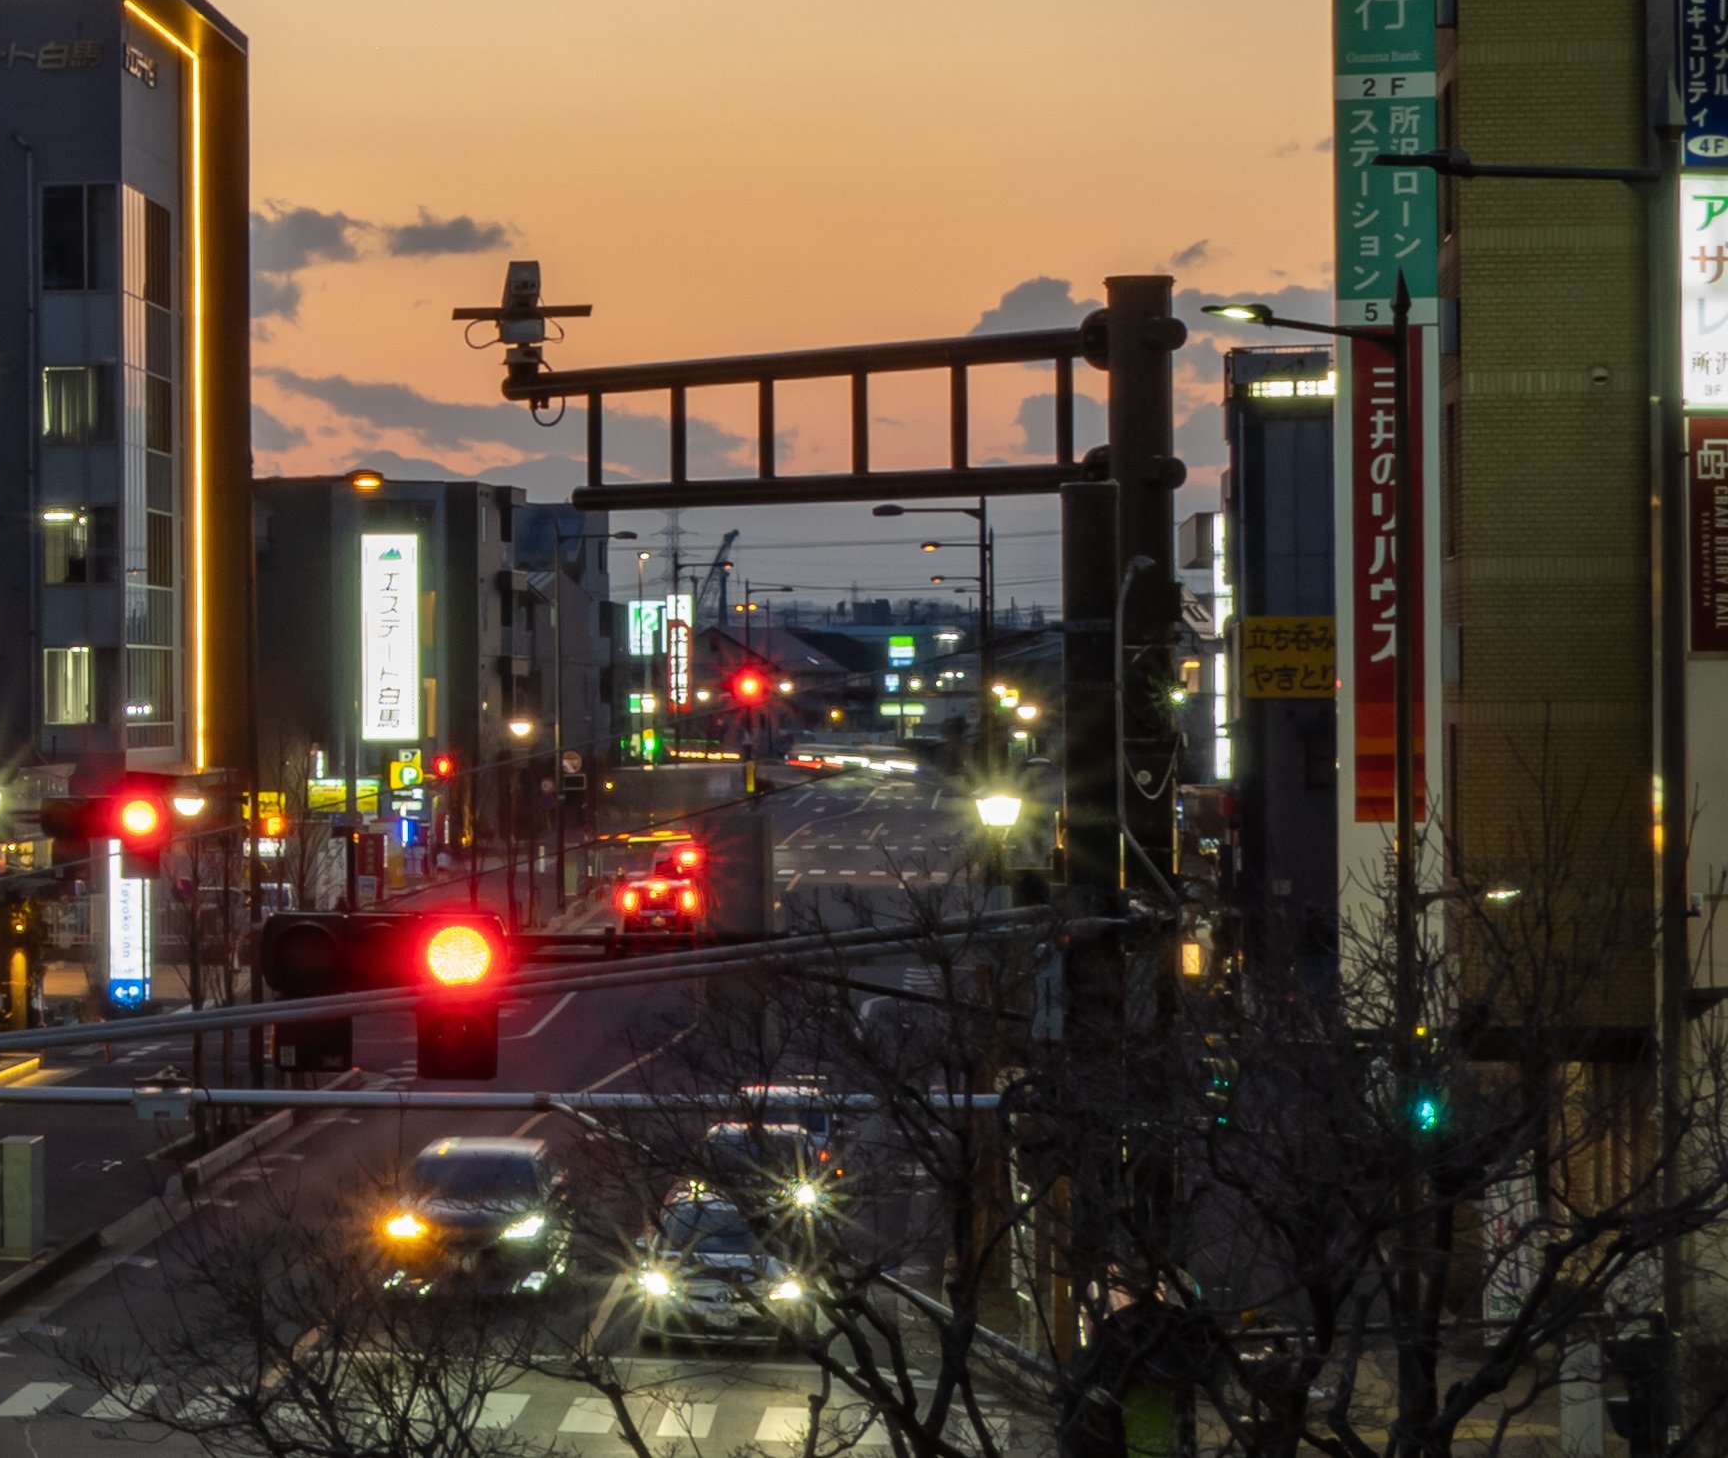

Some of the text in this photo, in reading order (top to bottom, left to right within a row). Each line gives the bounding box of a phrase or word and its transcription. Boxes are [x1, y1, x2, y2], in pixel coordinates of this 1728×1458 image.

[1698, 138, 1724, 154] 4F
[1349, 109, 1381, 292] ステーション
[377, 572, 401, 728] エステート白馬
[1249, 625, 1334, 651] 立ち呑み
[1251, 663, 1334, 690] やきとり
